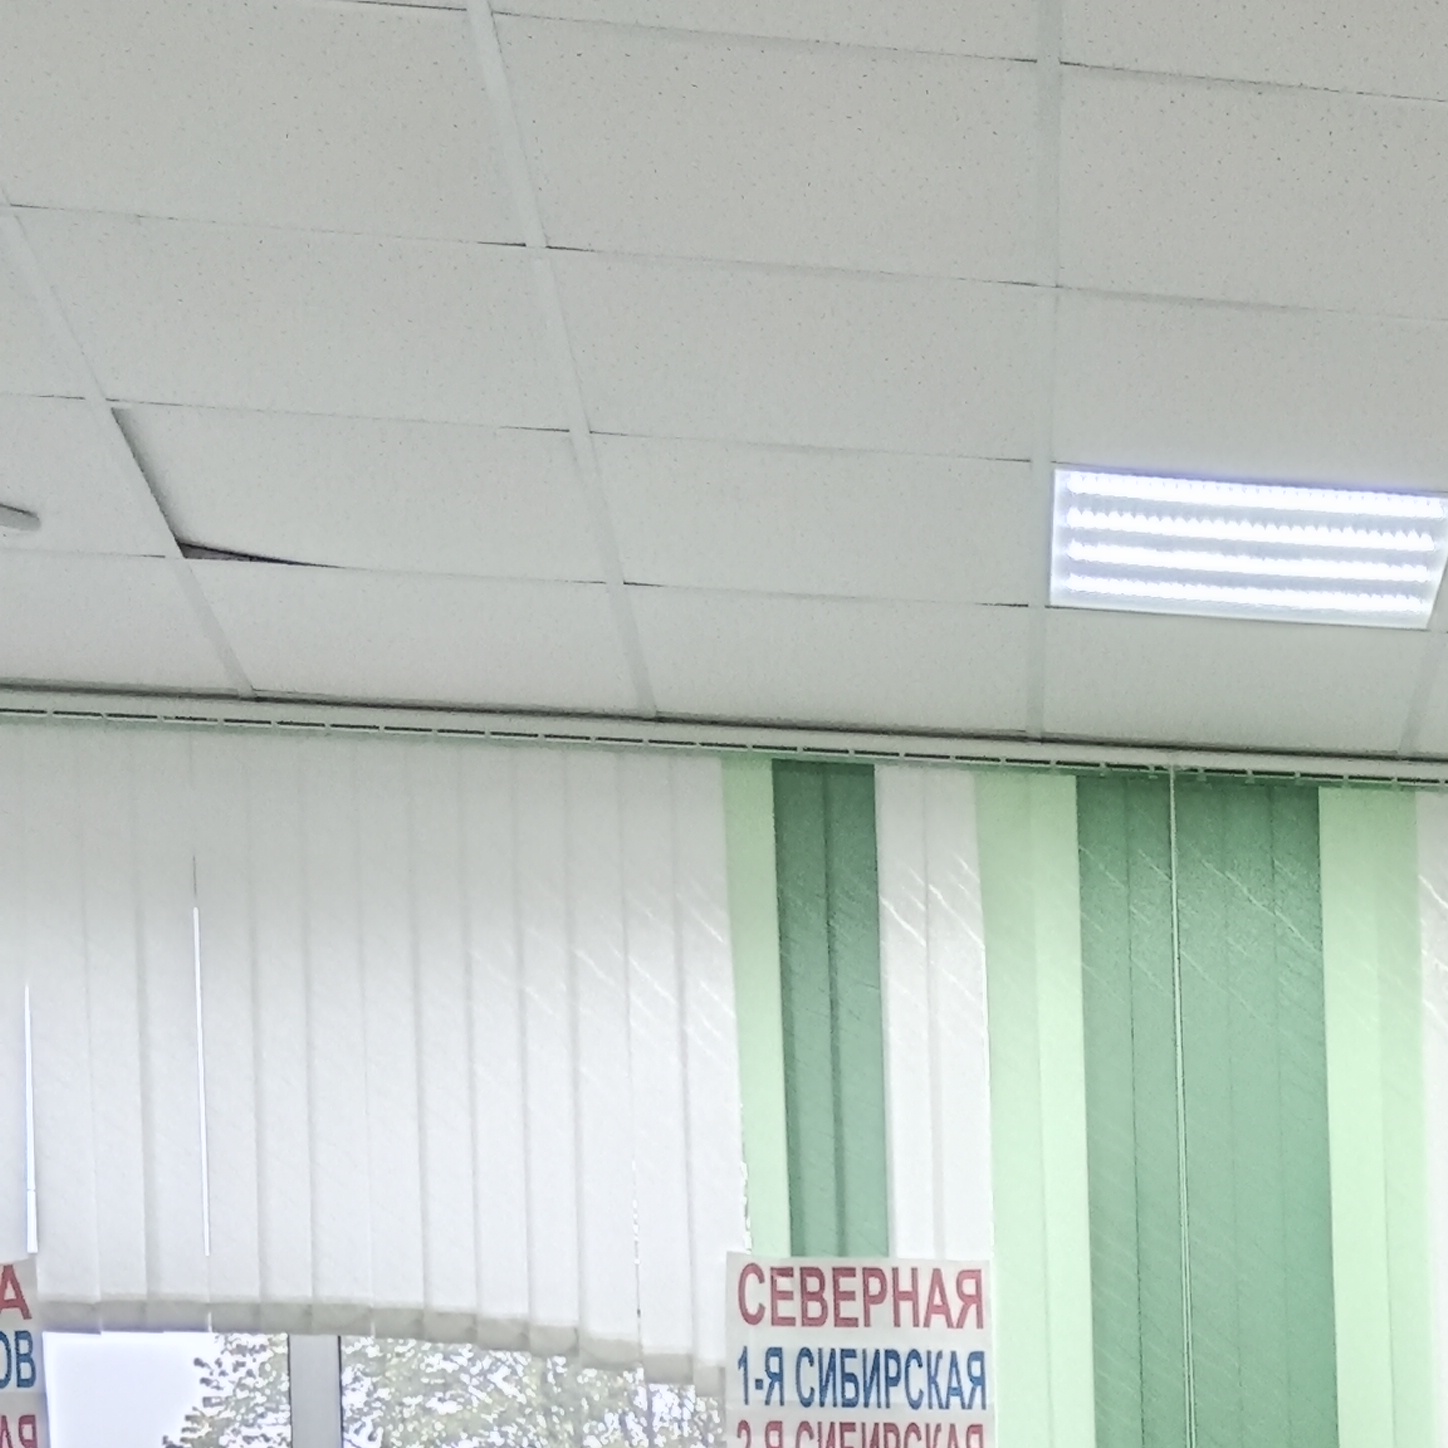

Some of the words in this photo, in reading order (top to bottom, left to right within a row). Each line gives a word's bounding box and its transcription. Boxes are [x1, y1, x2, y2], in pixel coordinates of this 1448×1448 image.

[738, 1266, 985, 1330] СЕВЕРНАЯ
[738, 1346, 784, 1407] 1-Я
[799, 1346, 987, 1411] СИБИРСКАЯ
